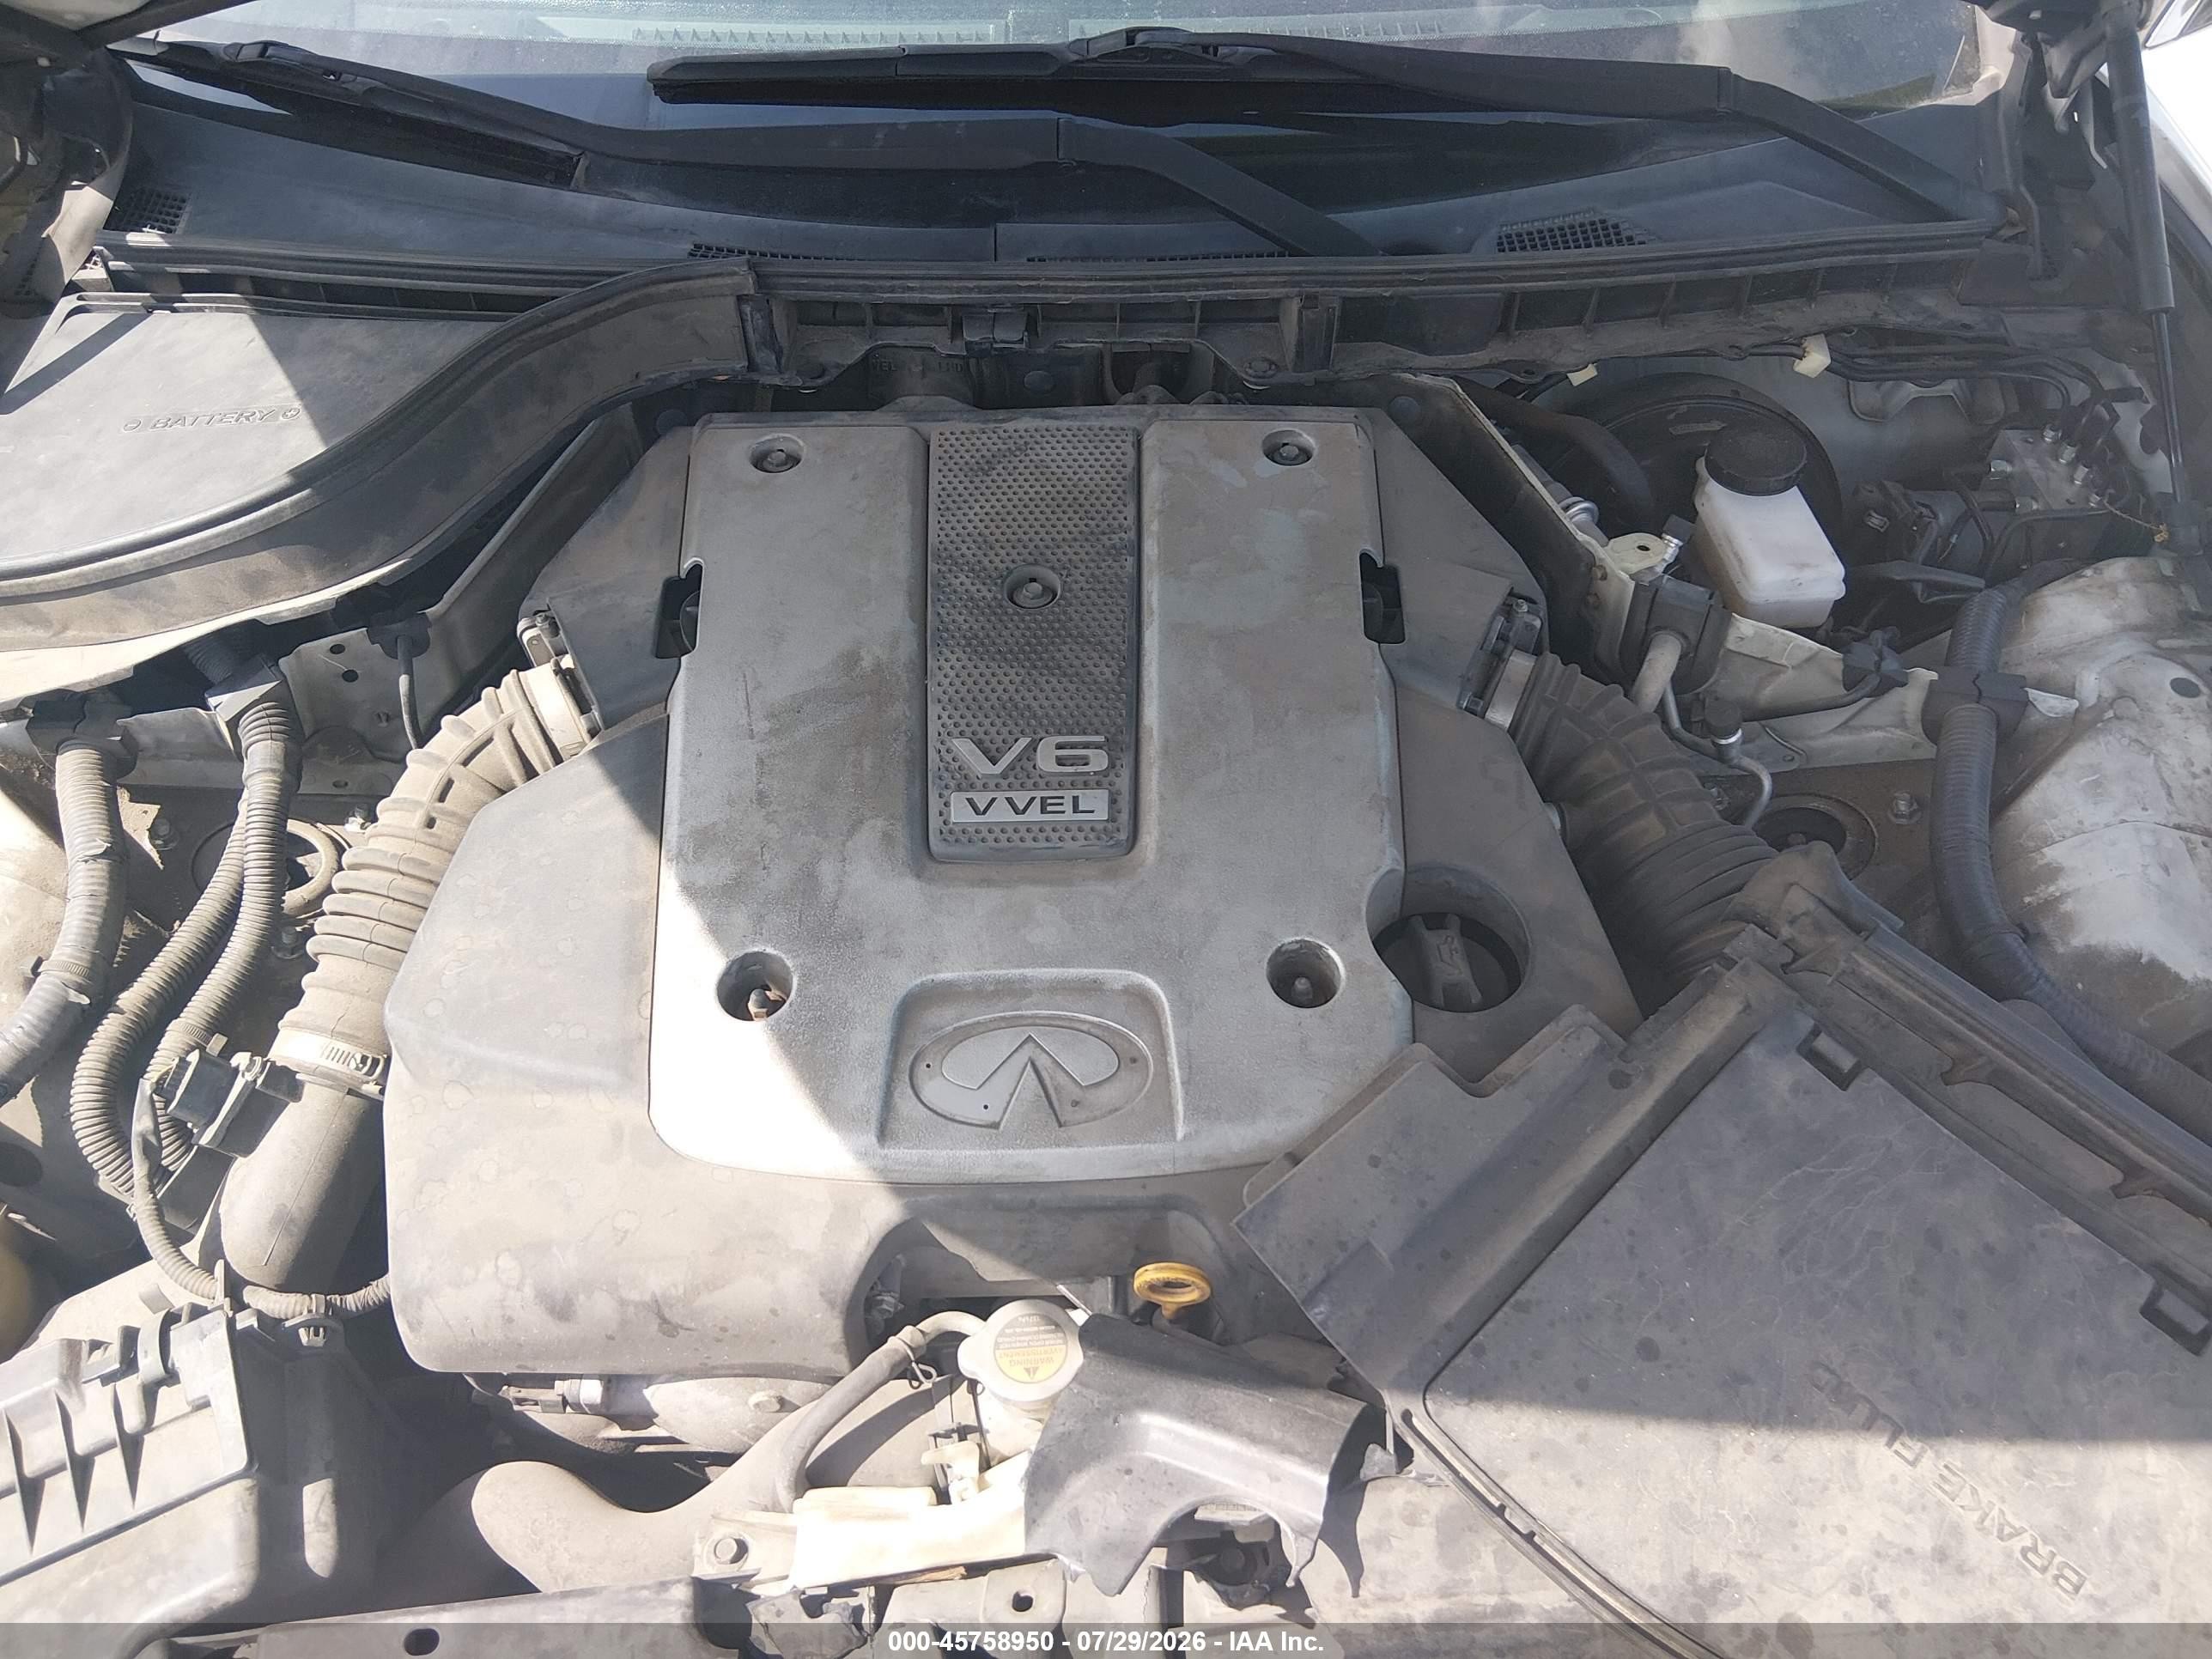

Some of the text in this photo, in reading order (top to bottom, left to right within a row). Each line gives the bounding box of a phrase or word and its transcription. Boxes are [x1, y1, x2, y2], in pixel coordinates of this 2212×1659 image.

[149, 408, 276, 430] BATTERY
[951, 735, 1109, 775] V6
[965, 795, 1096, 816] VVEL
[1009, 1357, 1054, 1367] WARNING
[1932, 1462, 2087, 1595] BRAKE
